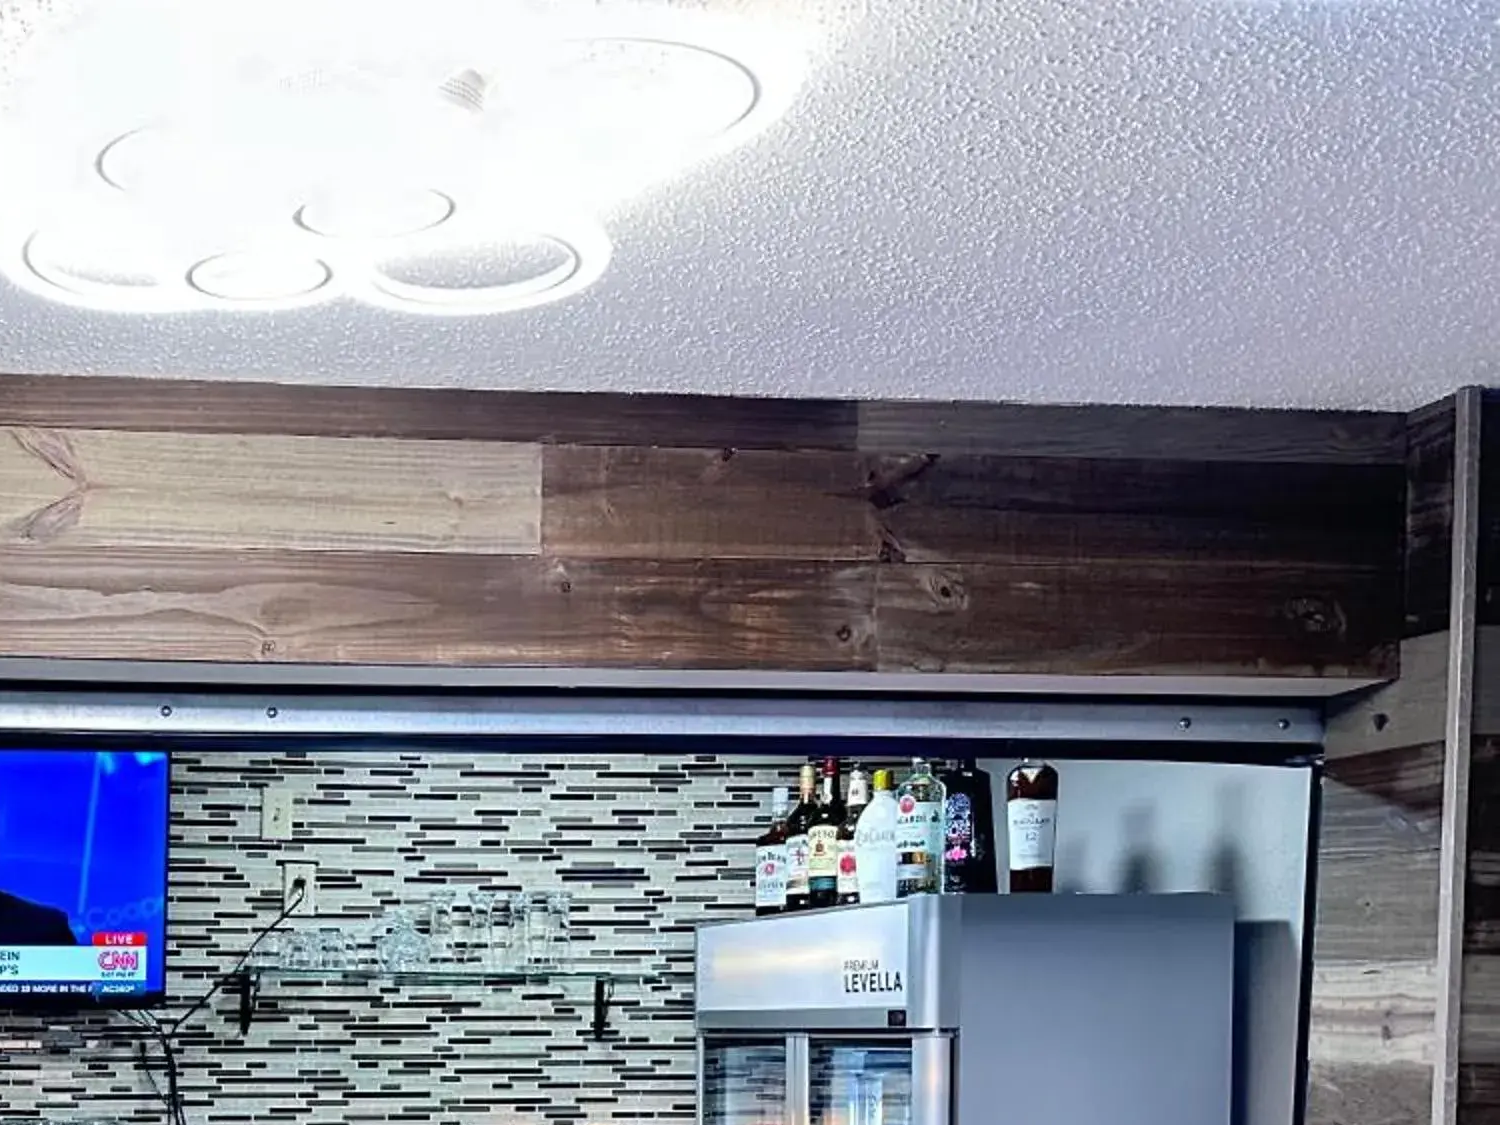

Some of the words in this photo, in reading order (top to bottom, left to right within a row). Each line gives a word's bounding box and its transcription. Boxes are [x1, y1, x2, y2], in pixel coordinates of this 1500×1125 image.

[105, 934, 133, 945] LIVE
[97, 950, 140, 971] CNN
[32, 984, 58, 993] MORE
[59, 984, 69, 993] IN
[70, 984, 87, 993] THE
[843, 971, 903, 993] LEVELLA
